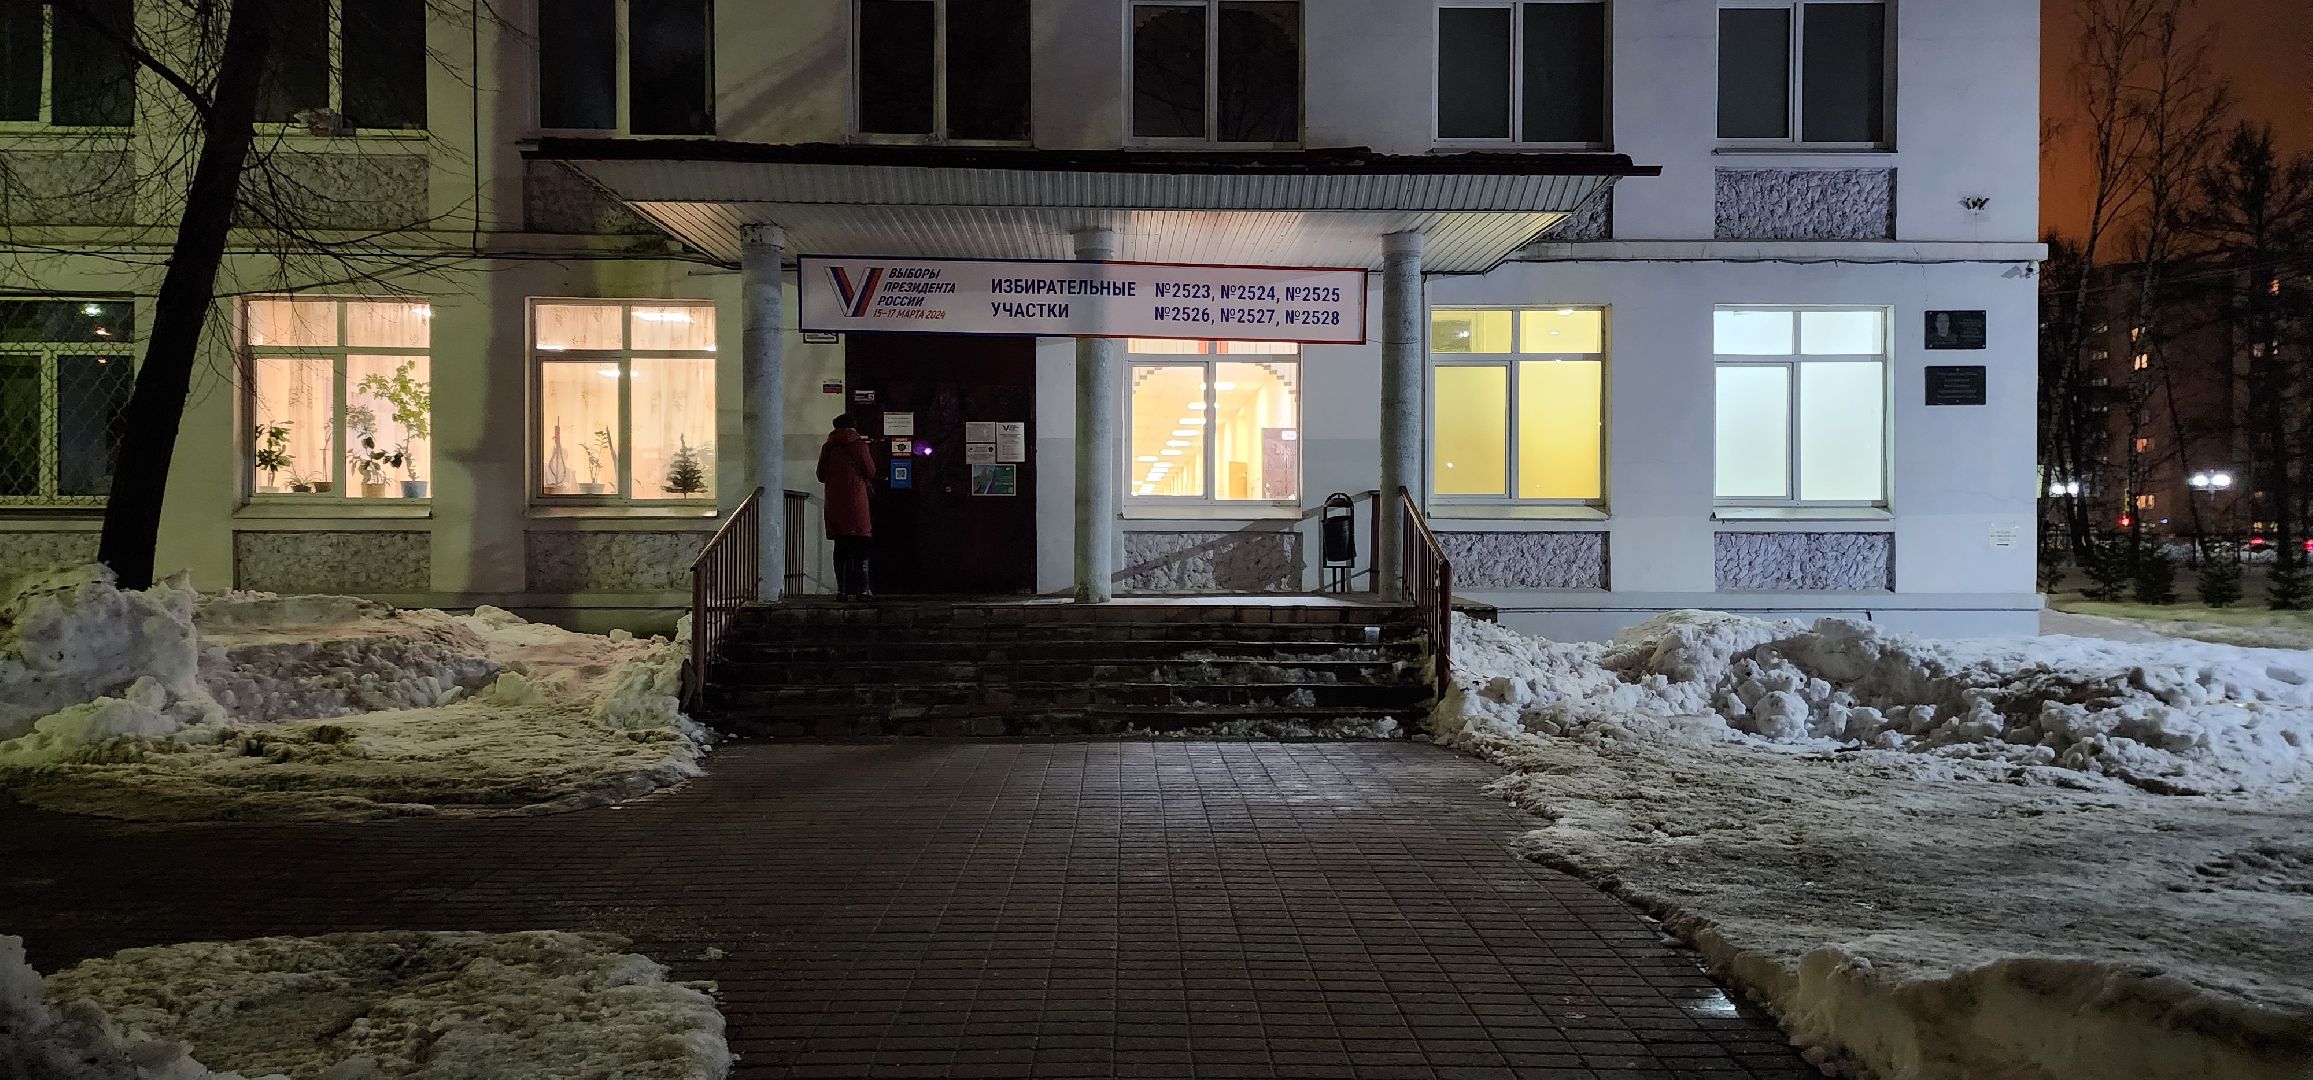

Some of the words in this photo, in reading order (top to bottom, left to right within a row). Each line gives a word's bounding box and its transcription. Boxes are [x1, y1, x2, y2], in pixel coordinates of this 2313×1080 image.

[888, 267, 941, 279] ВЫБОРЫ
[883, 282, 956, 294] ПРЕЗИДЕНТА
[991, 278, 1136, 297] ИЗБИРАТЕЛЬНЫЕ
[1155, 282, 1215, 302] №2523,
[1220, 284, 1280, 304] №2524,
[1285, 286, 1340, 302] №2525
[877, 296, 925, 307] РОССИИ
[896, 309, 925, 319] МАРТА
[925, 310, 946, 319] 2024
[991, 302, 1069, 318] УЧАСТКИ
[1154, 306, 1215, 325] №2526,
[1220, 307, 1280, 327] №2527,
[1285, 310, 1340, 326] №2528
